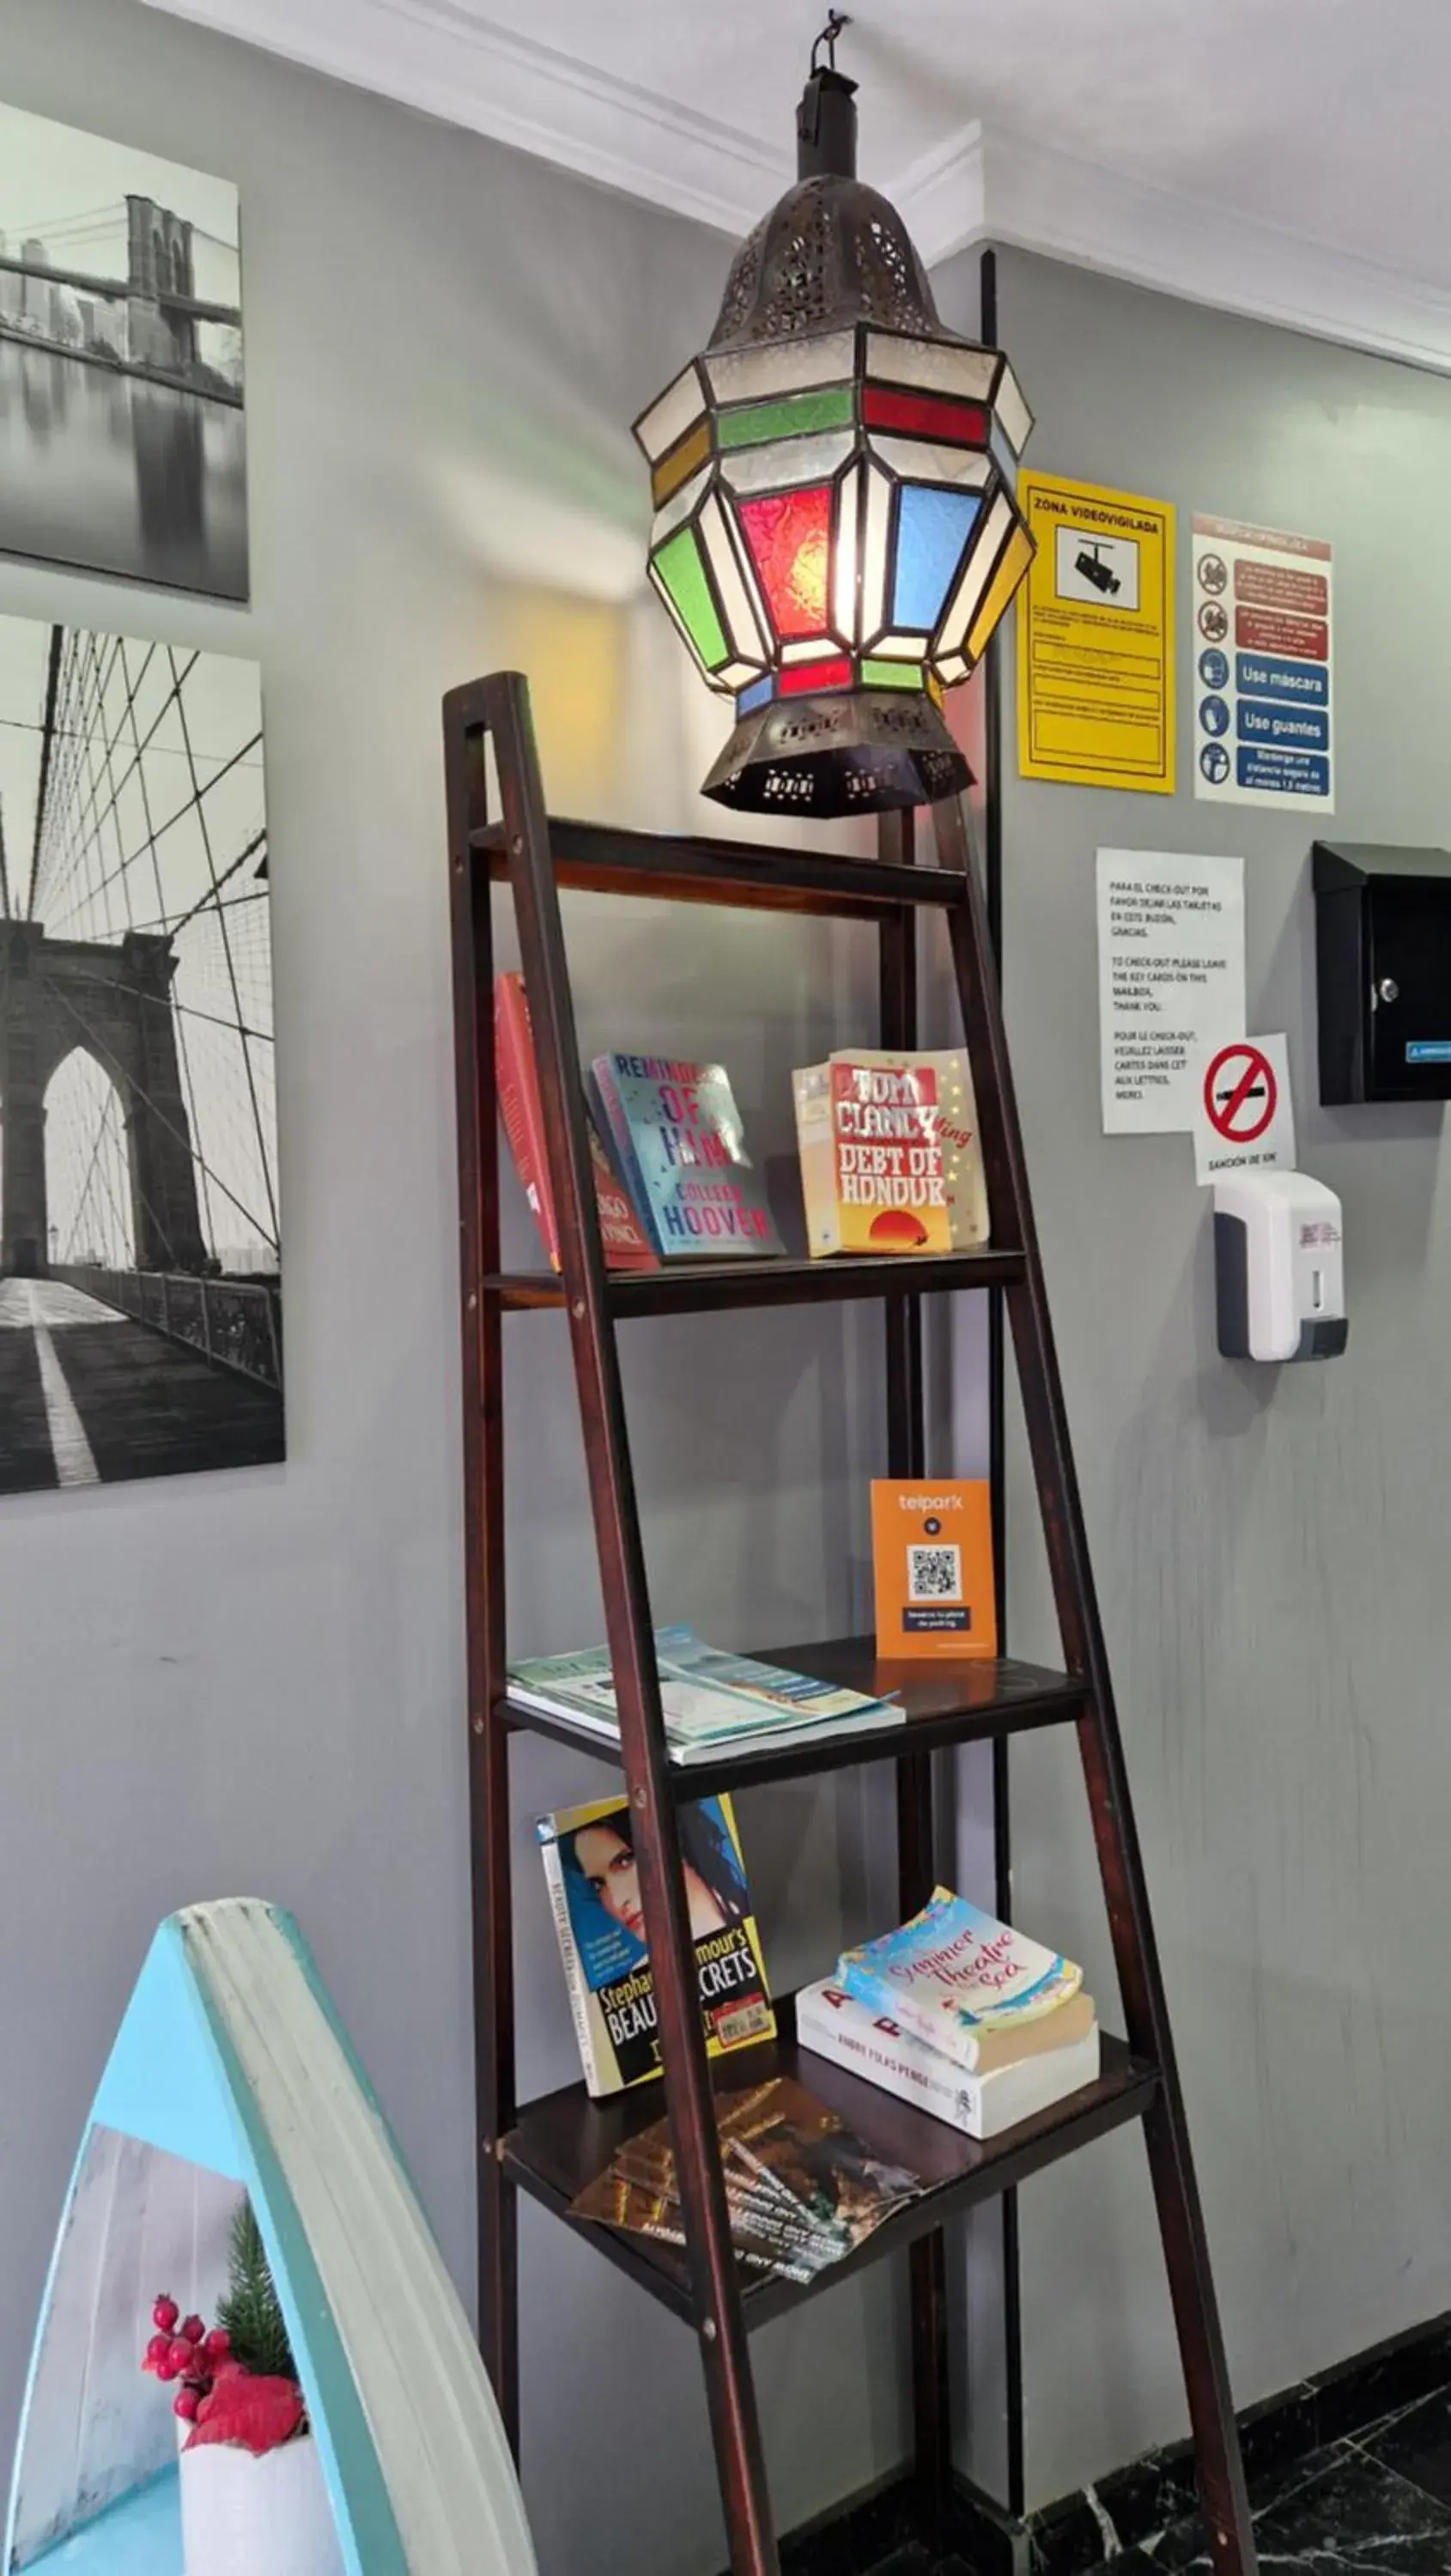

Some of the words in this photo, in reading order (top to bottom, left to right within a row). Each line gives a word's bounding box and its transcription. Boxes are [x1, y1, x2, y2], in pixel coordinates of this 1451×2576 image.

[1034, 496, 1068, 517] ZONA
[1072, 505, 1159, 535] VIDEOVIGILADA
[1243, 665, 1267, 683] Use
[1271, 668, 1322, 693] máscara
[1245, 711, 1268, 730] Use
[1272, 715, 1321, 738] guantes
[1248, 762, 1282, 777] distancia
[1110, 882, 1131, 892] PARA
[1132, 883, 1144, 893] EL
[1192, 886, 1208, 896] POR
[1111, 896, 1138, 908] FAVOR
[1140, 898, 1166, 908] DEJAR
[1169, 900, 1182, 910] LAS
[1183, 900, 1221, 911] TARJETAS
[1111, 913, 1122, 922] EN
[1124, 913, 1143, 923] ESTE
[1113, 957, 1123, 967] TO
[1125, 957, 1170, 968] CHECK-OUT
[1173, 958, 1200, 969] PLEASE
[1202, 959, 1226, 969] LEAVE
[1113, 972, 1127, 981] THE
[1130, 972, 1145, 982] KEY
[1148, 973, 1175, 982] CARDS
[1190, 974, 1206, 983] THIS
[1114, 1001, 1142, 1012] THANK
[1114, 1031, 1137, 1042] POUR
[1138, 1032, 1148, 1042] LE
[1114, 1046, 1152, 1056] VEUILLEZ
[1154, 1046, 1185, 1056] LAISSER
[1115, 1060, 1146, 1071] CARTES
[1148, 1060, 1169, 1070] DANS
[853, 1068, 920, 1105] TOM
[1115, 1075, 1132, 1085] AUX
[658, 1085, 699, 1124] OF
[835, 1101, 940, 1146] CLANCY
[660, 1126, 734, 1168] HIM
[839, 1144, 903, 1176] DEBT
[908, 1145, 943, 1176] OF
[1249, 1154, 1260, 1166] DE
[675, 1182, 742, 1202] COLLEEN
[841, 1174, 947, 1207] HONOUR
[664, 1206, 773, 1238] HOOVER
[898, 1494, 964, 1513] telpark
[889, 1928, 974, 1984] Summer
[599, 1972, 654, 2014] Stepha
[695, 1927, 746, 1962] mour's
[980, 1961, 1028, 1991] Sea
[608, 1993, 658, 2045] BEAU
[699, 1947, 756, 2002] CRETS
